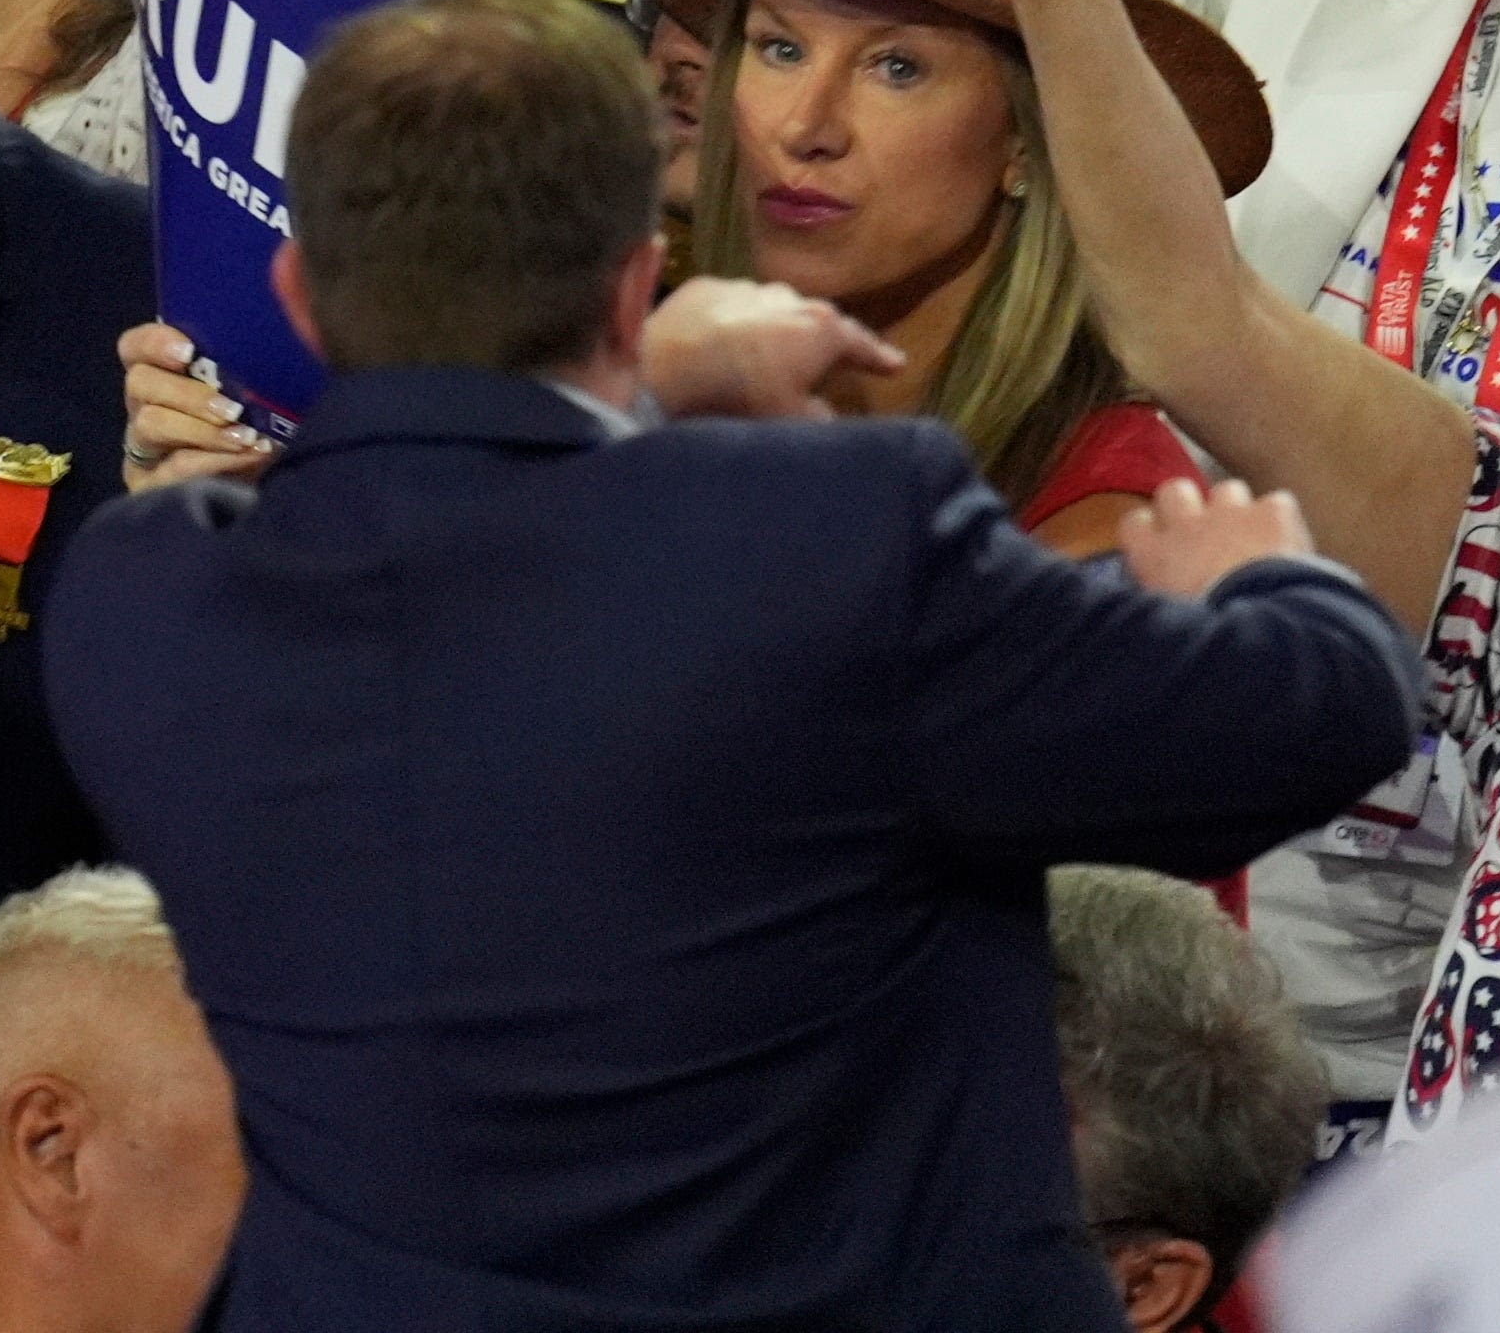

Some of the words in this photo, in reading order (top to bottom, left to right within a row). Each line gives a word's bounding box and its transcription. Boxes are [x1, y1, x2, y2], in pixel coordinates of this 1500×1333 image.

[145, 57, 201, 169] RICA
[207, 156, 294, 239] GREA
[1389, 269, 1413, 324] TRUST
